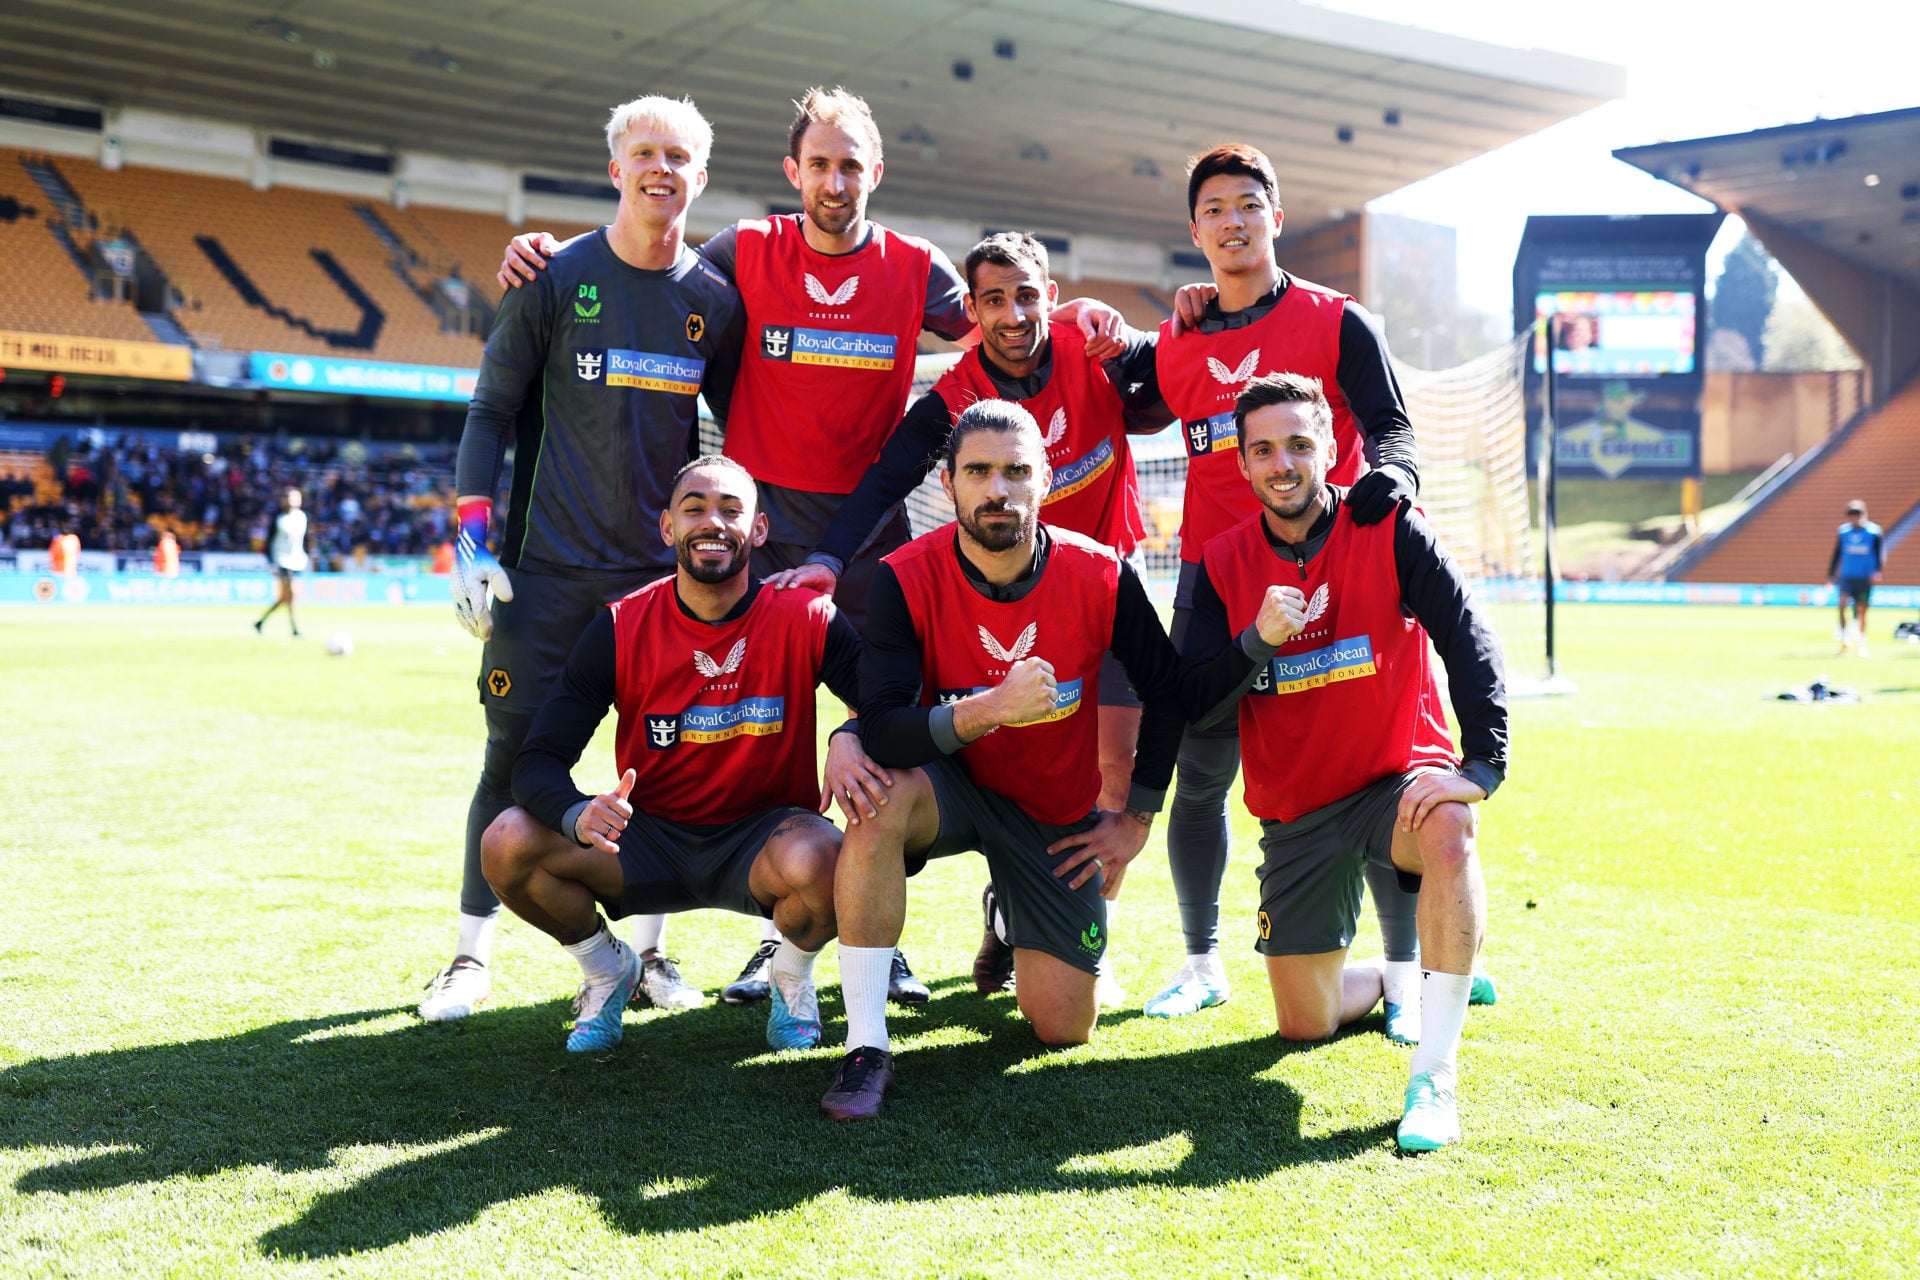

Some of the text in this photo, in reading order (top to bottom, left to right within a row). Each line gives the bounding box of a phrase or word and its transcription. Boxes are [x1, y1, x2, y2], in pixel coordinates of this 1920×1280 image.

[795, 355, 893, 369] INTERNATIONAL
[611, 377, 697, 393] INTERNATIONAL
[1290, 628, 1329, 642] ASTORE
[684, 725, 781, 740] INTERNATIONAL
